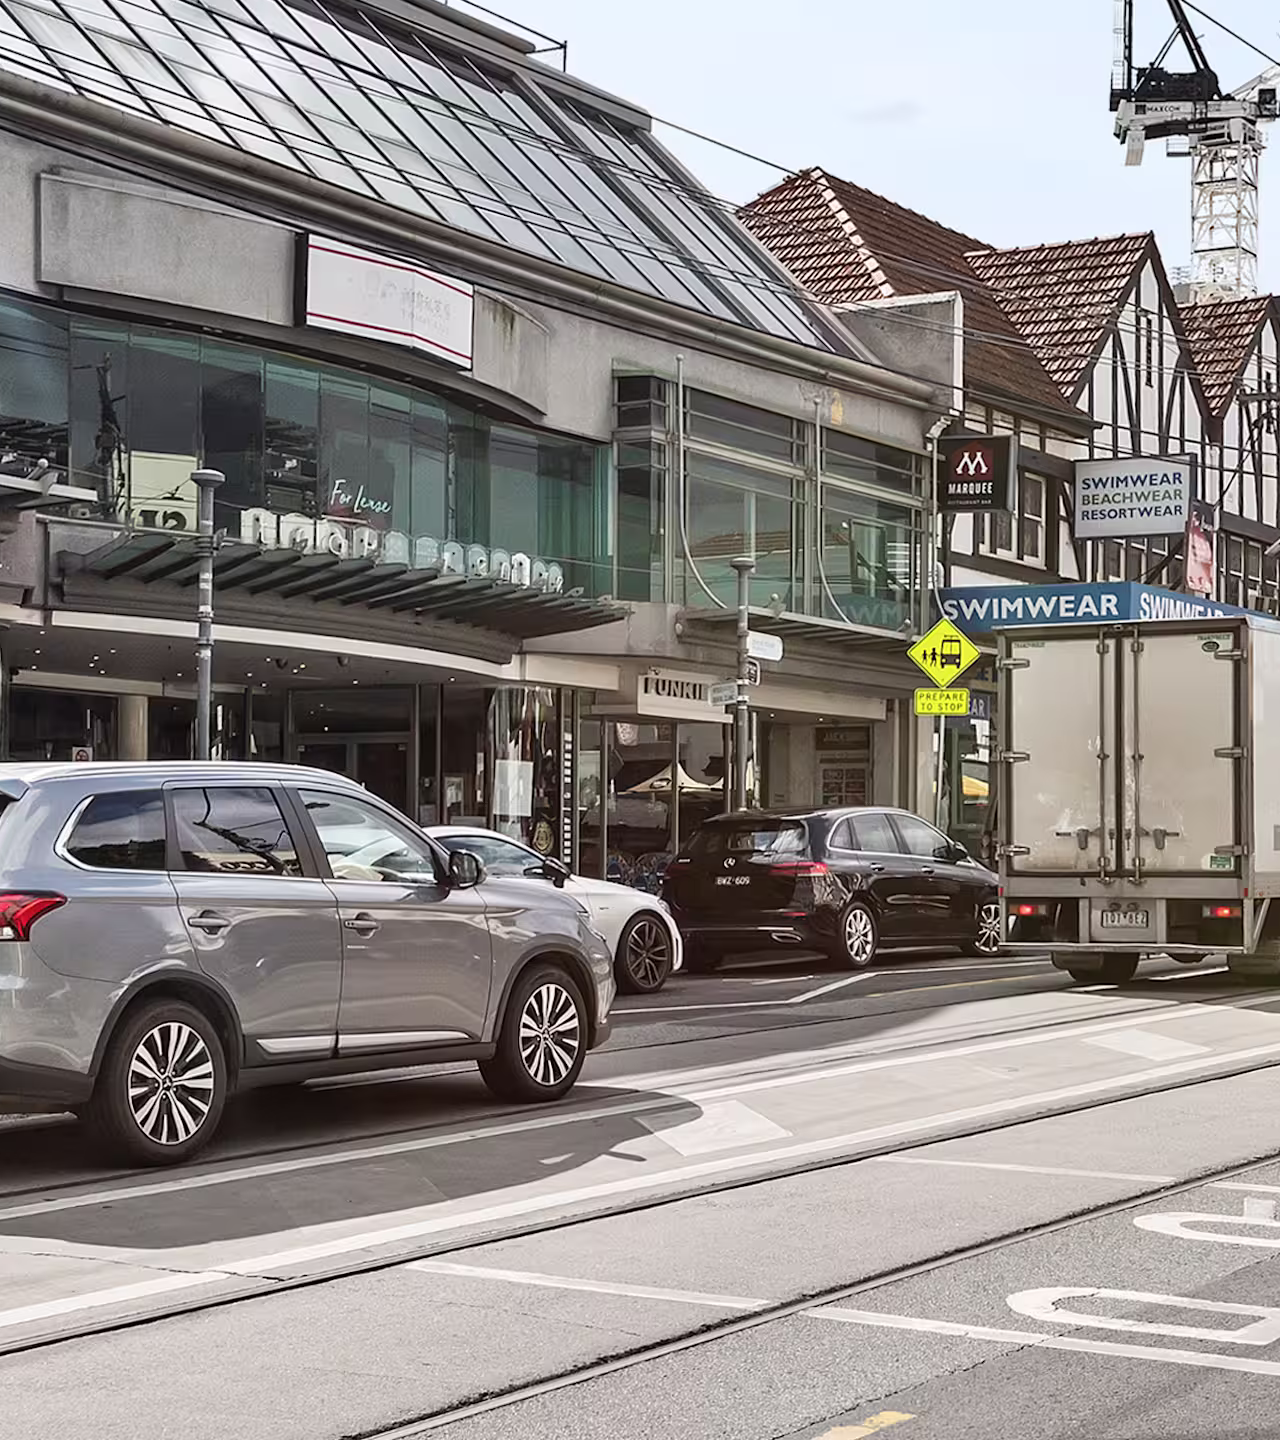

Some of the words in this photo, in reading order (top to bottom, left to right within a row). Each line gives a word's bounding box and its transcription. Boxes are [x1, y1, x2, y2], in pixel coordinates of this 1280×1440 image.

[947, 482, 994, 495] MARQUEE
[1081, 472, 1184, 490] SWIMWEAR
[330, 478, 352, 506] For
[353, 484, 392, 513] Lease
[1081, 488, 1184, 506] BEACHWEAR
[1081, 504, 1184, 521] RESORTWEAR
[943, 594, 1120, 621] SWIMWEAR
[919, 692, 965, 702] PREPARE
[921, 703, 934, 711] TO
[938, 703, 964, 712] STOP
